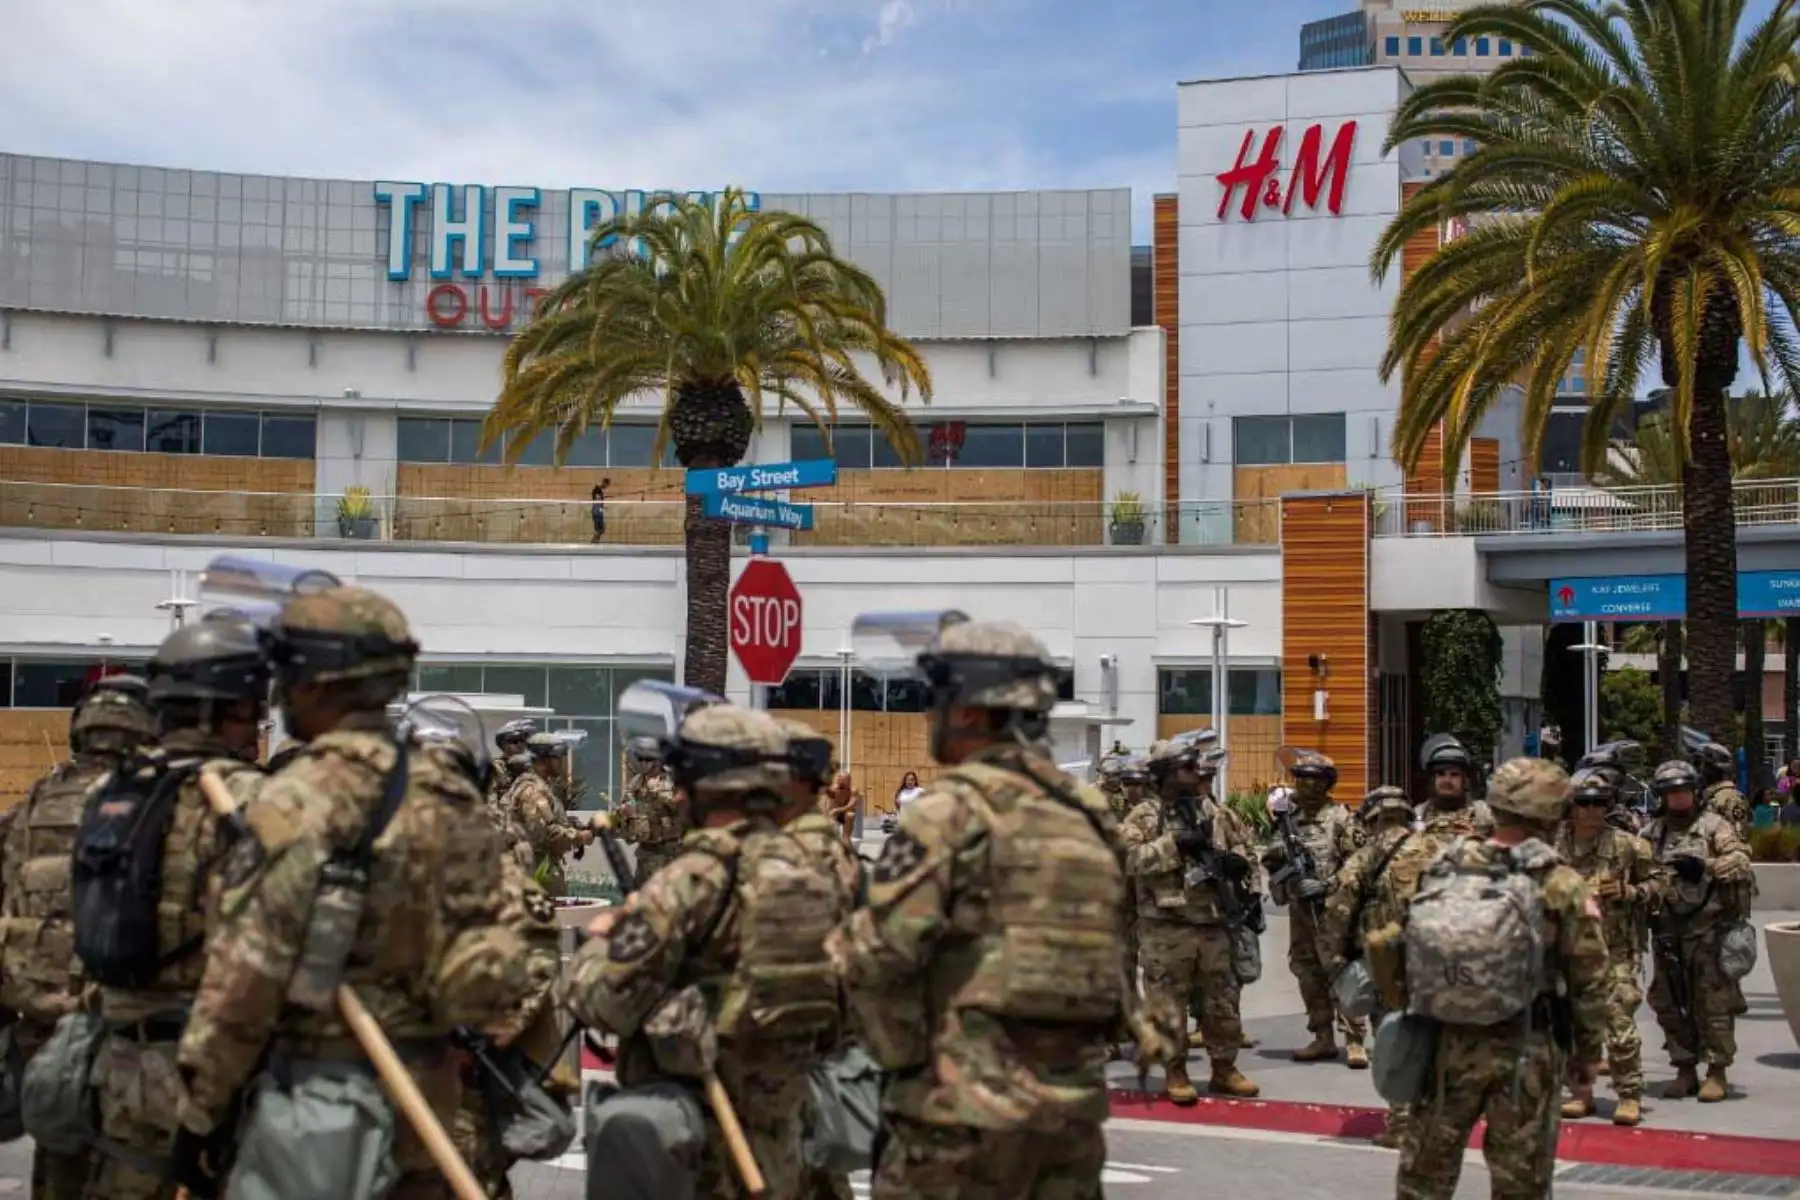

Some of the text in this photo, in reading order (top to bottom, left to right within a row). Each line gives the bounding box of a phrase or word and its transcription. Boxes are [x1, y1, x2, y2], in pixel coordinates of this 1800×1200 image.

[1216, 120, 1357, 222] H&M
[375, 181, 540, 281] THE
[717, 467, 799, 492] Bay Street
[720, 496, 803, 529] Aquarium Way
[733, 595, 799, 648] STOP
[1444, 963, 1474, 987] US
